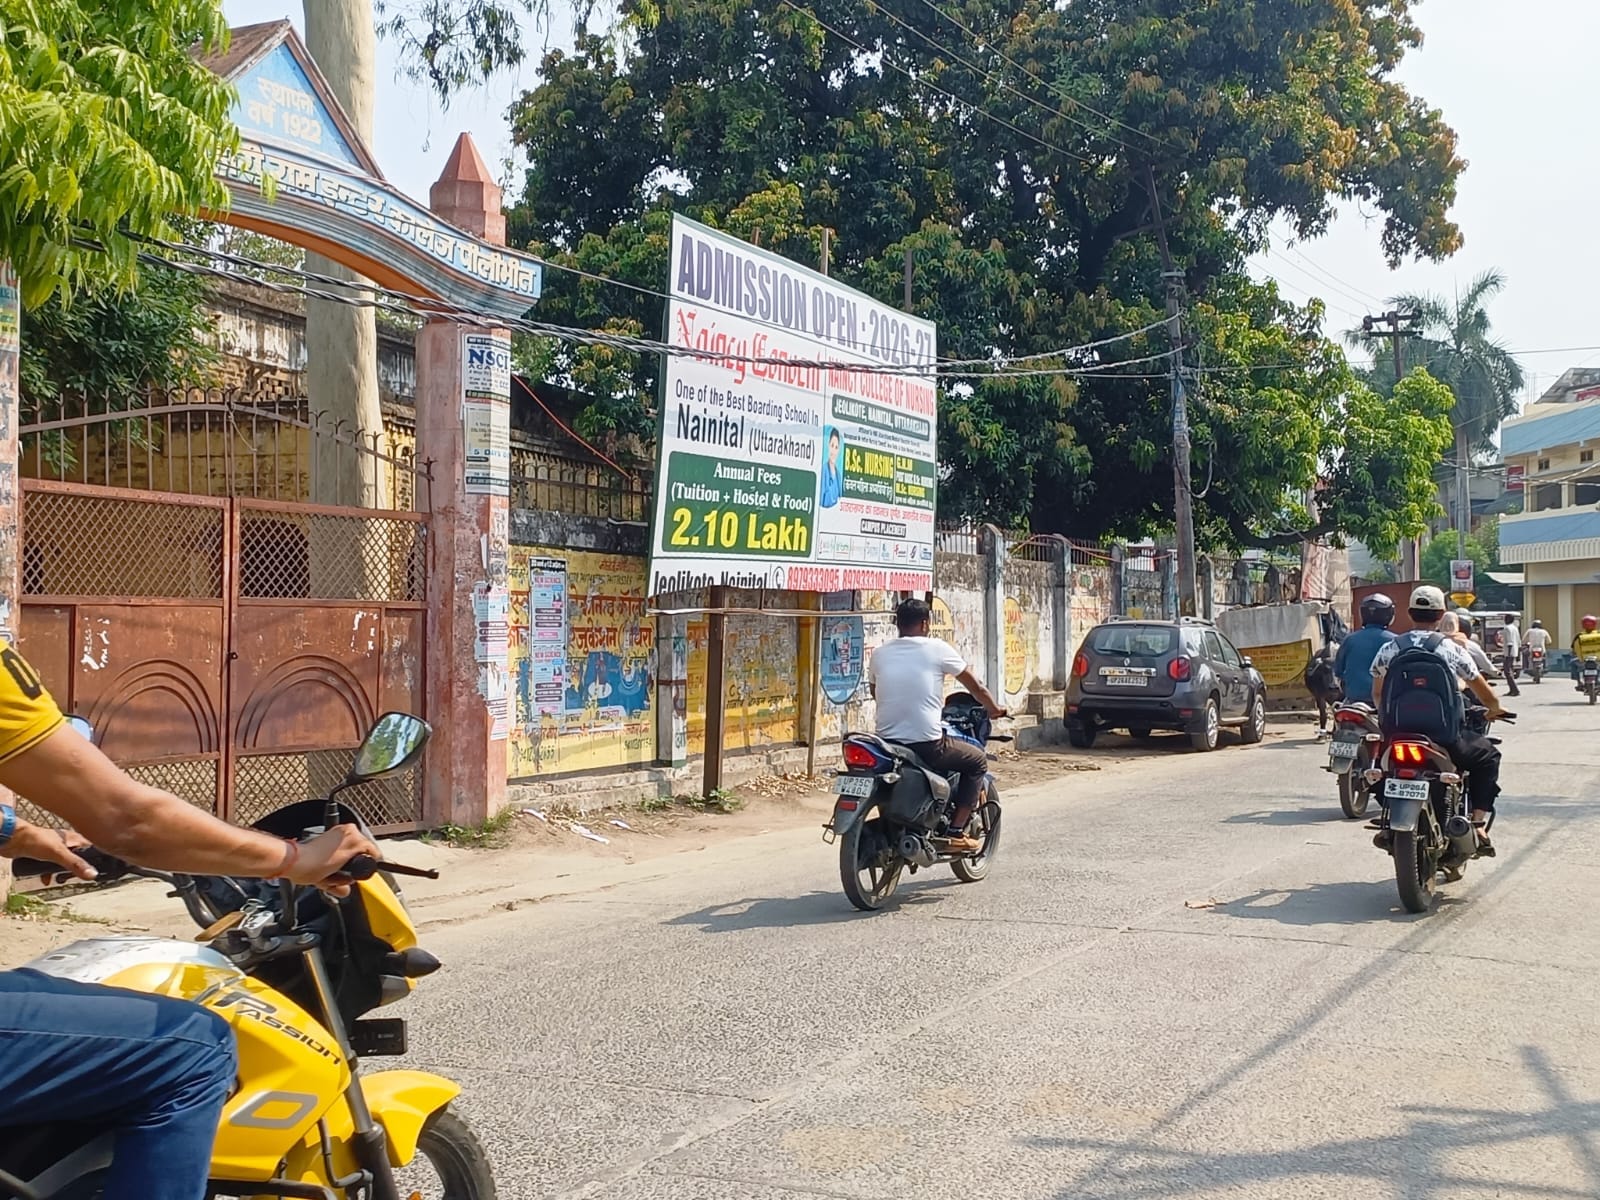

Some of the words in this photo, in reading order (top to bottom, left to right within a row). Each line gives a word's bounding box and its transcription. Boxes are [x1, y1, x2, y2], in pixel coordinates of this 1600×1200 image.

[283, 111, 322, 145] 1922
[458, 242, 536, 294] पीलीभीत
[677, 233, 807, 333] ADMISSION
[812, 286, 857, 351] OPEN
[869, 309, 933, 376] 2026-27
[468, 349, 508, 370] NSCI
[676, 379, 695, 401] One
[697, 385, 708, 402] of
[709, 387, 724, 407] the
[726, 390, 745, 412] Best
[747, 395, 783, 421] Boarding
[785, 403, 810, 424] School
[860, 369, 892, 404] COLLEGE
[895, 377, 904, 408] OF
[906, 381, 934, 416] NURSING
[677, 403, 744, 448] Nainital
[749, 428, 815, 466] (Uttarakhand)
[714, 462, 754, 483] Annual
[757, 467, 781, 486] Fees
[865, 452, 893, 479] NURSING
[671, 482, 720, 503] (Tuition
[724, 492, 730, 503] +
[733, 488, 768, 507] Hostel
[772, 495, 781, 508] &
[783, 494, 812, 514] Food)
[671, 508, 739, 548] 2.10
[747, 513, 808, 552] Lakh
